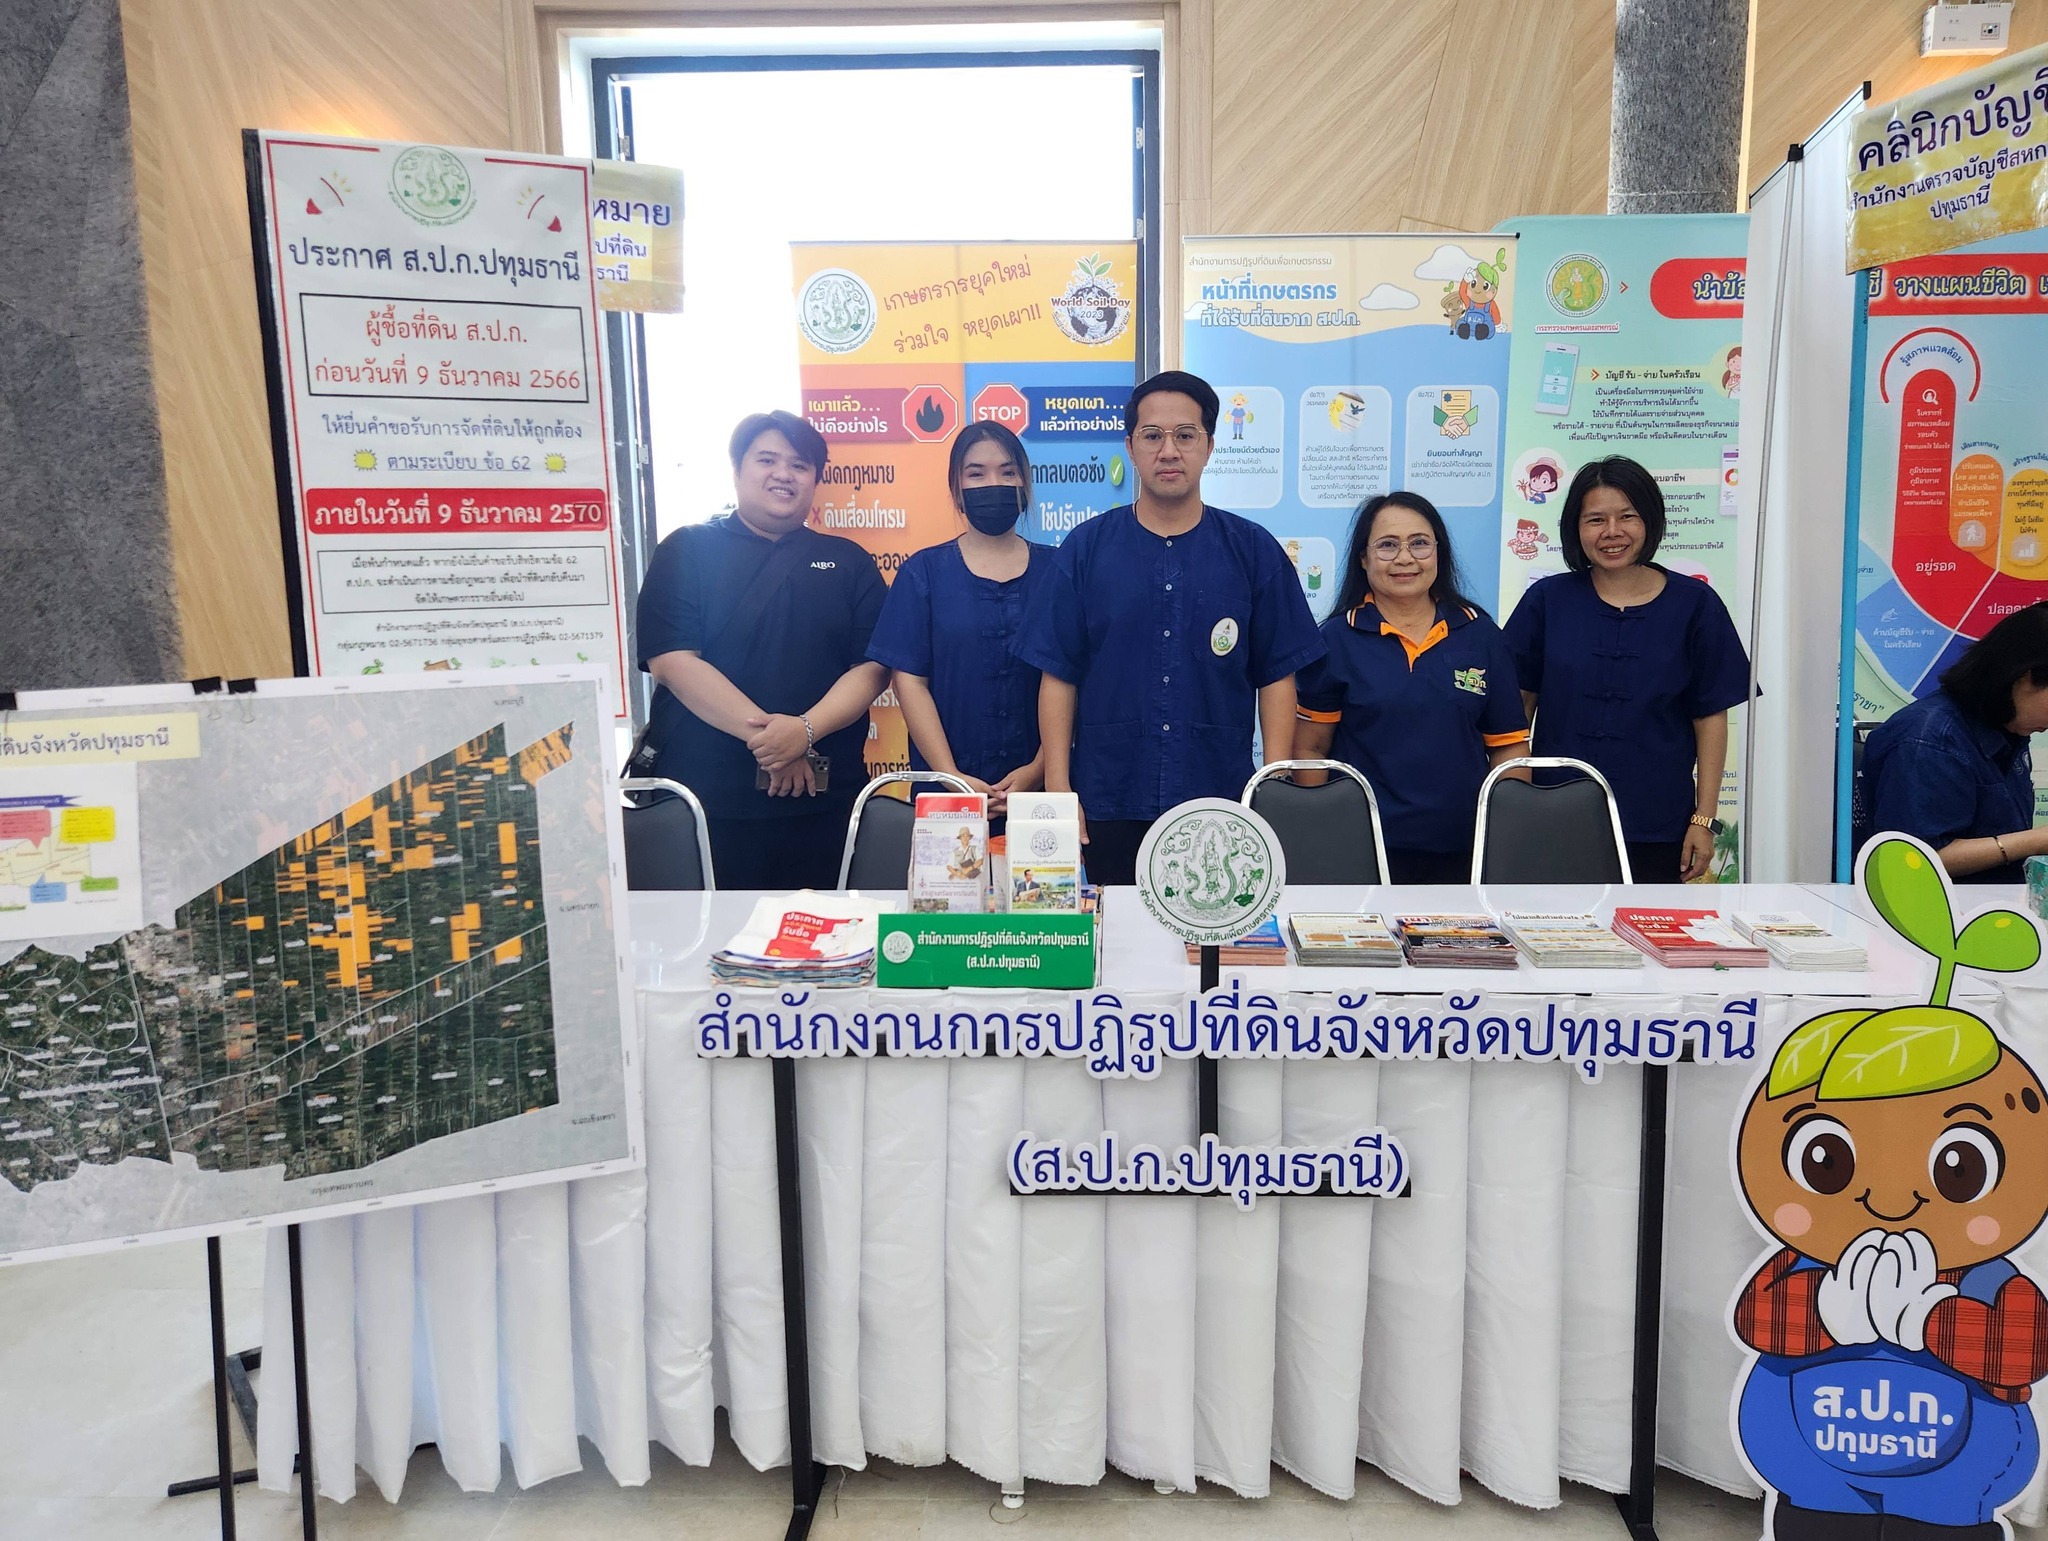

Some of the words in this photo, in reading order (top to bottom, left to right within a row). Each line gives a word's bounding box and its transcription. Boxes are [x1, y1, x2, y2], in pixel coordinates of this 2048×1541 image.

[1930, 183, 1991, 220] ปทุมธานี
[288, 236, 393, 271] ประกาศ
[403, 249, 581, 288] ส.ป.ก.ปทุมธานี
[883, 254, 1033, 312] เกษตรกรยุคใหม่
[1202, 273, 1337, 301] หน้าที่เกษตรกร
[1894, 267, 2025, 297] วางแผนชีวิต
[1051, 297, 1083, 307] World
[1086, 297, 1107, 307] Soil
[1110, 297, 1131, 308] Day
[1080, 310, 1104, 319] 2023
[1200, 302, 1312, 328] ที่ได้รับที่ดินจาก
[1317, 310, 1361, 328] ส.ป.ก.
[466, 319, 528, 345] ส.ป.ก.
[893, 324, 950, 354] ร่วมใจ
[1900, 345, 1963, 367] รู้สภาพแวดล้อม
[314, 353, 408, 386] ก่อนวันที่
[417, 365, 429, 386] 9
[438, 360, 522, 389] ธันวาคม
[530, 370, 581, 391] 2566
[1626, 369, 1636, 379] รับ
[1643, 370, 1658, 379] จ่าย
[1659, 369, 1701, 379] ในครัวเรือน
[978, 405, 1022, 422] STOP
[1044, 396, 1125, 414] หยุดเผา...
[322, 411, 583, 443] ให้ยื่นคำขอรับการจัดที่ดินให้ถูกต้อง
[1039, 415, 1126, 433] แล้วทำอย่างไร
[387, 451, 477, 471] ตามระเบียบ
[484, 450, 505, 470] ข้อ
[511, 456, 532, 470] 62
[314, 493, 431, 527] ภายในวันที่
[438, 504, 451, 524] 9
[460, 500, 542, 524] ธันวาคม
[549, 502, 602, 524] 2570
[823, 495, 906, 530] ดินเสื่อมโทรม
[566, 555, 578, 565] 62
[1915, 558, 1956, 576] อยู่รอด
[0, 726, 170, 756] ดินจังหวัดปทุมธานี
[916, 928, 1089, 953] สำนักงานการปฏิรูปที่ดินจังหวัดปทุมธานี
[966, 953, 1041, 971] (ส.ป.ก.ปทุมธานี)
[697, 979, 1757, 1078] สำนักงานการปฏิรูปที่ดินจังหวัดปทุมธานี
[1012, 1133, 1403, 1206] (ส.ป.ก.ปทุมธานี)
[1813, 1379, 1954, 1426] ส.ป.ก.
[1815, 1424, 1937, 1462] ปทุมธานี
